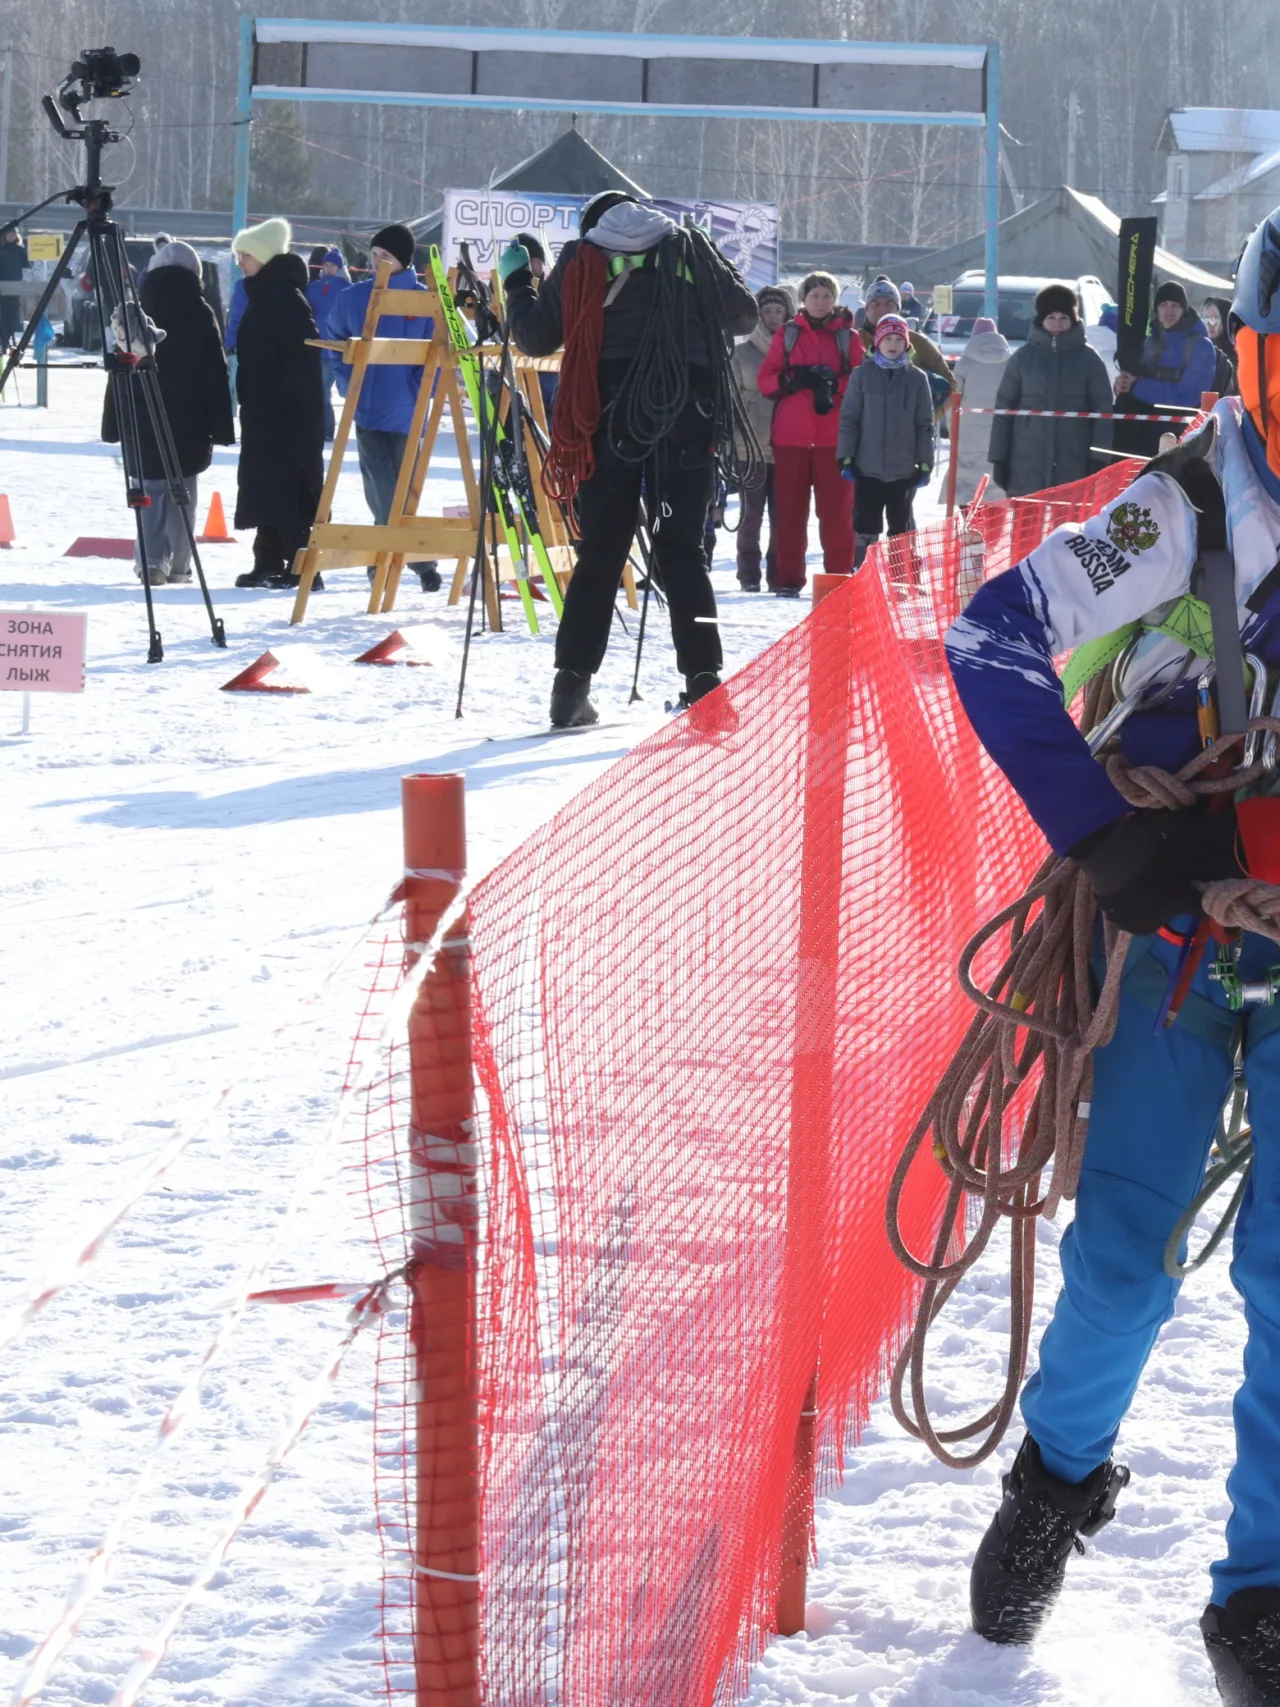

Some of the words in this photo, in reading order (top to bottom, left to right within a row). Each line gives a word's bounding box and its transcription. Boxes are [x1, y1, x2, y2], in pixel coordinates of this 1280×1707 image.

[455, 199, 712, 234] СПОРТЙ
[1125, 243, 1138, 326] FISCHER
[1064, 534, 1115, 596] RUSSIA
[7, 620, 54, 635] ЗОНА
[6, 667, 50, 682] ЛЫЖ
